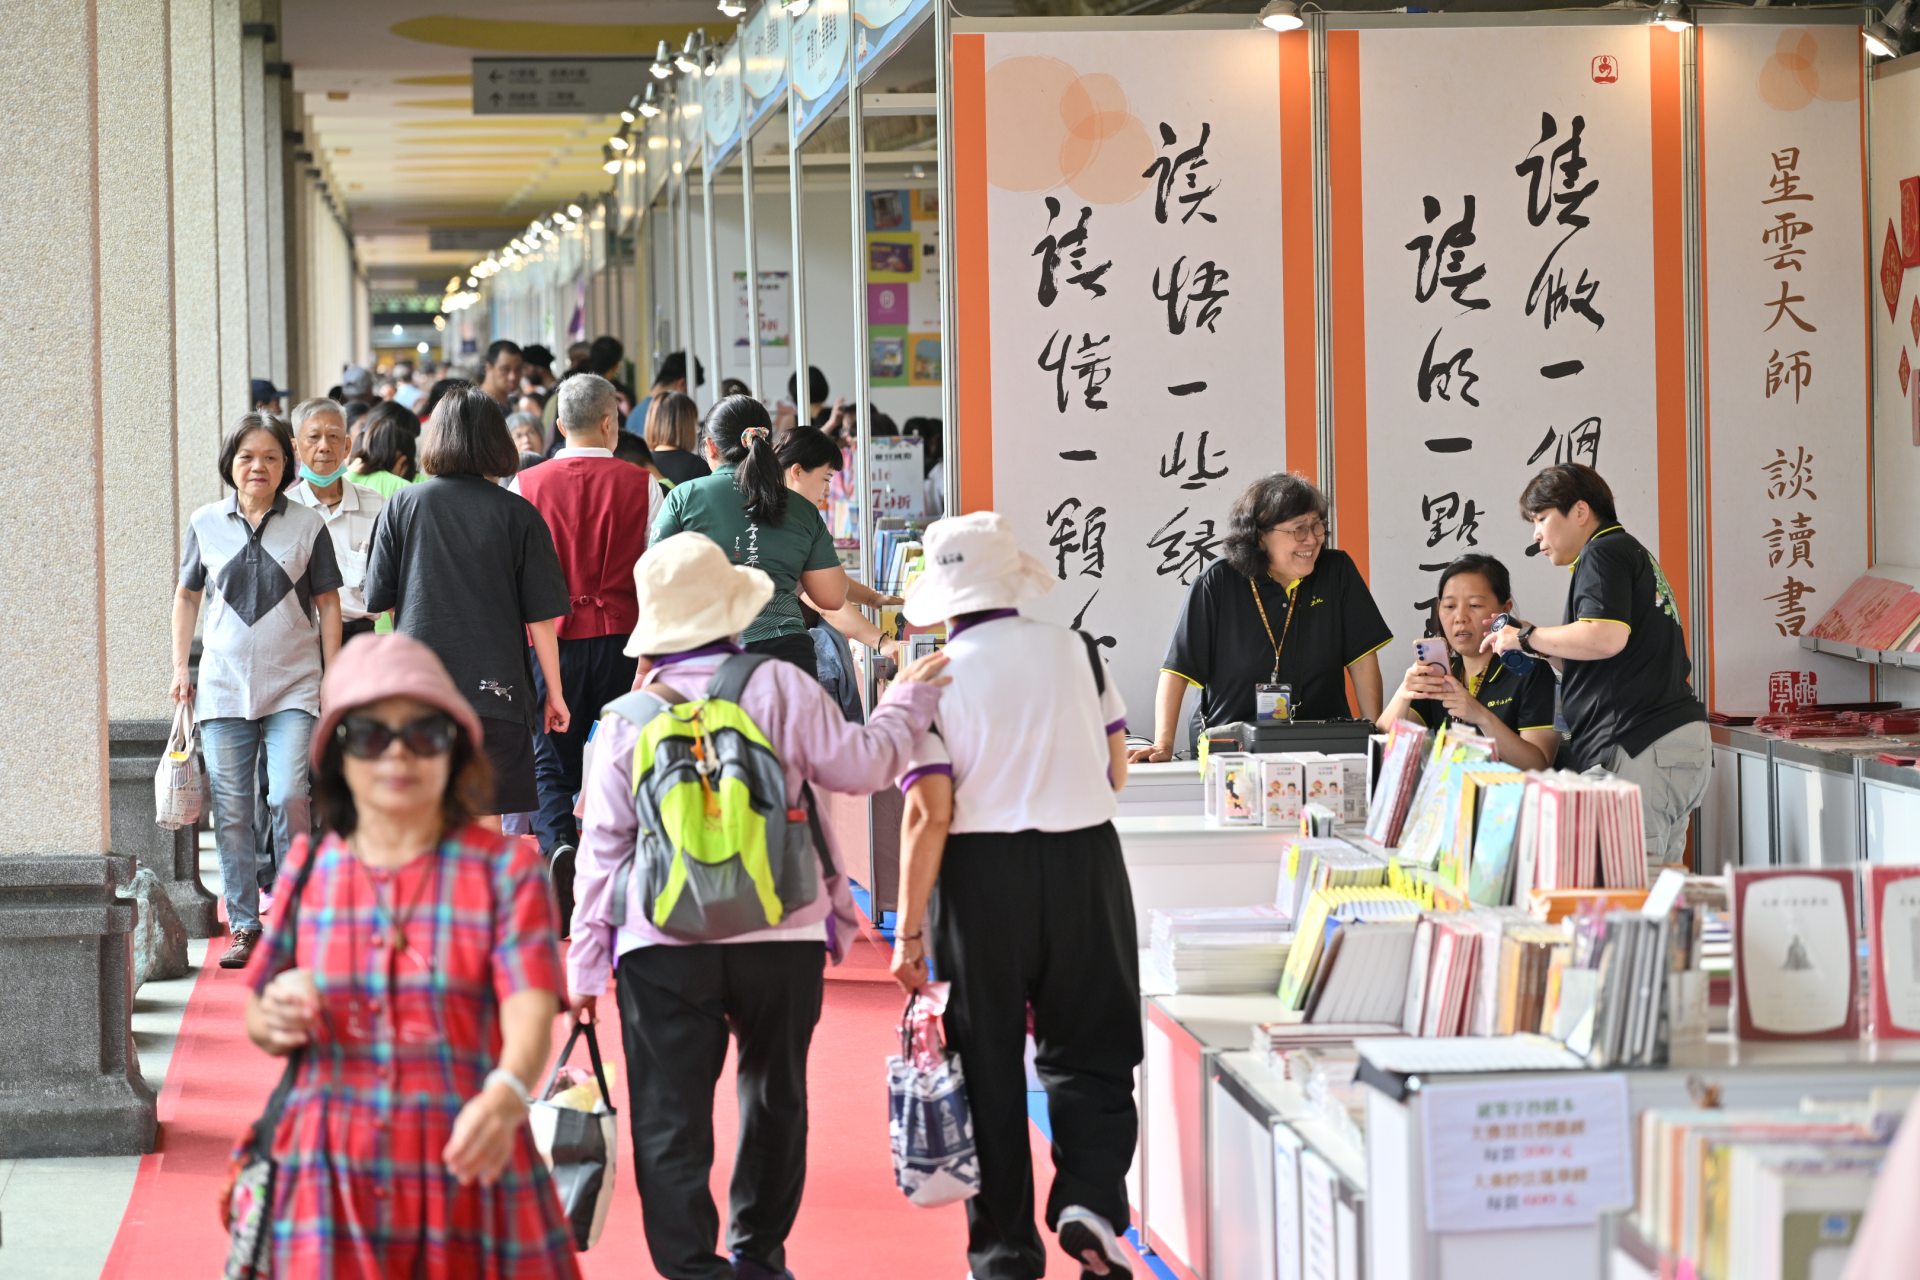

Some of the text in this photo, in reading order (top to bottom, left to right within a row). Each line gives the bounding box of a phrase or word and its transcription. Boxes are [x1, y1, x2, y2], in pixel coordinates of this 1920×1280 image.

[1515, 111, 1605, 558] 讀做一個
[1761, 146, 1817, 637] 星雲大師 談讀書
